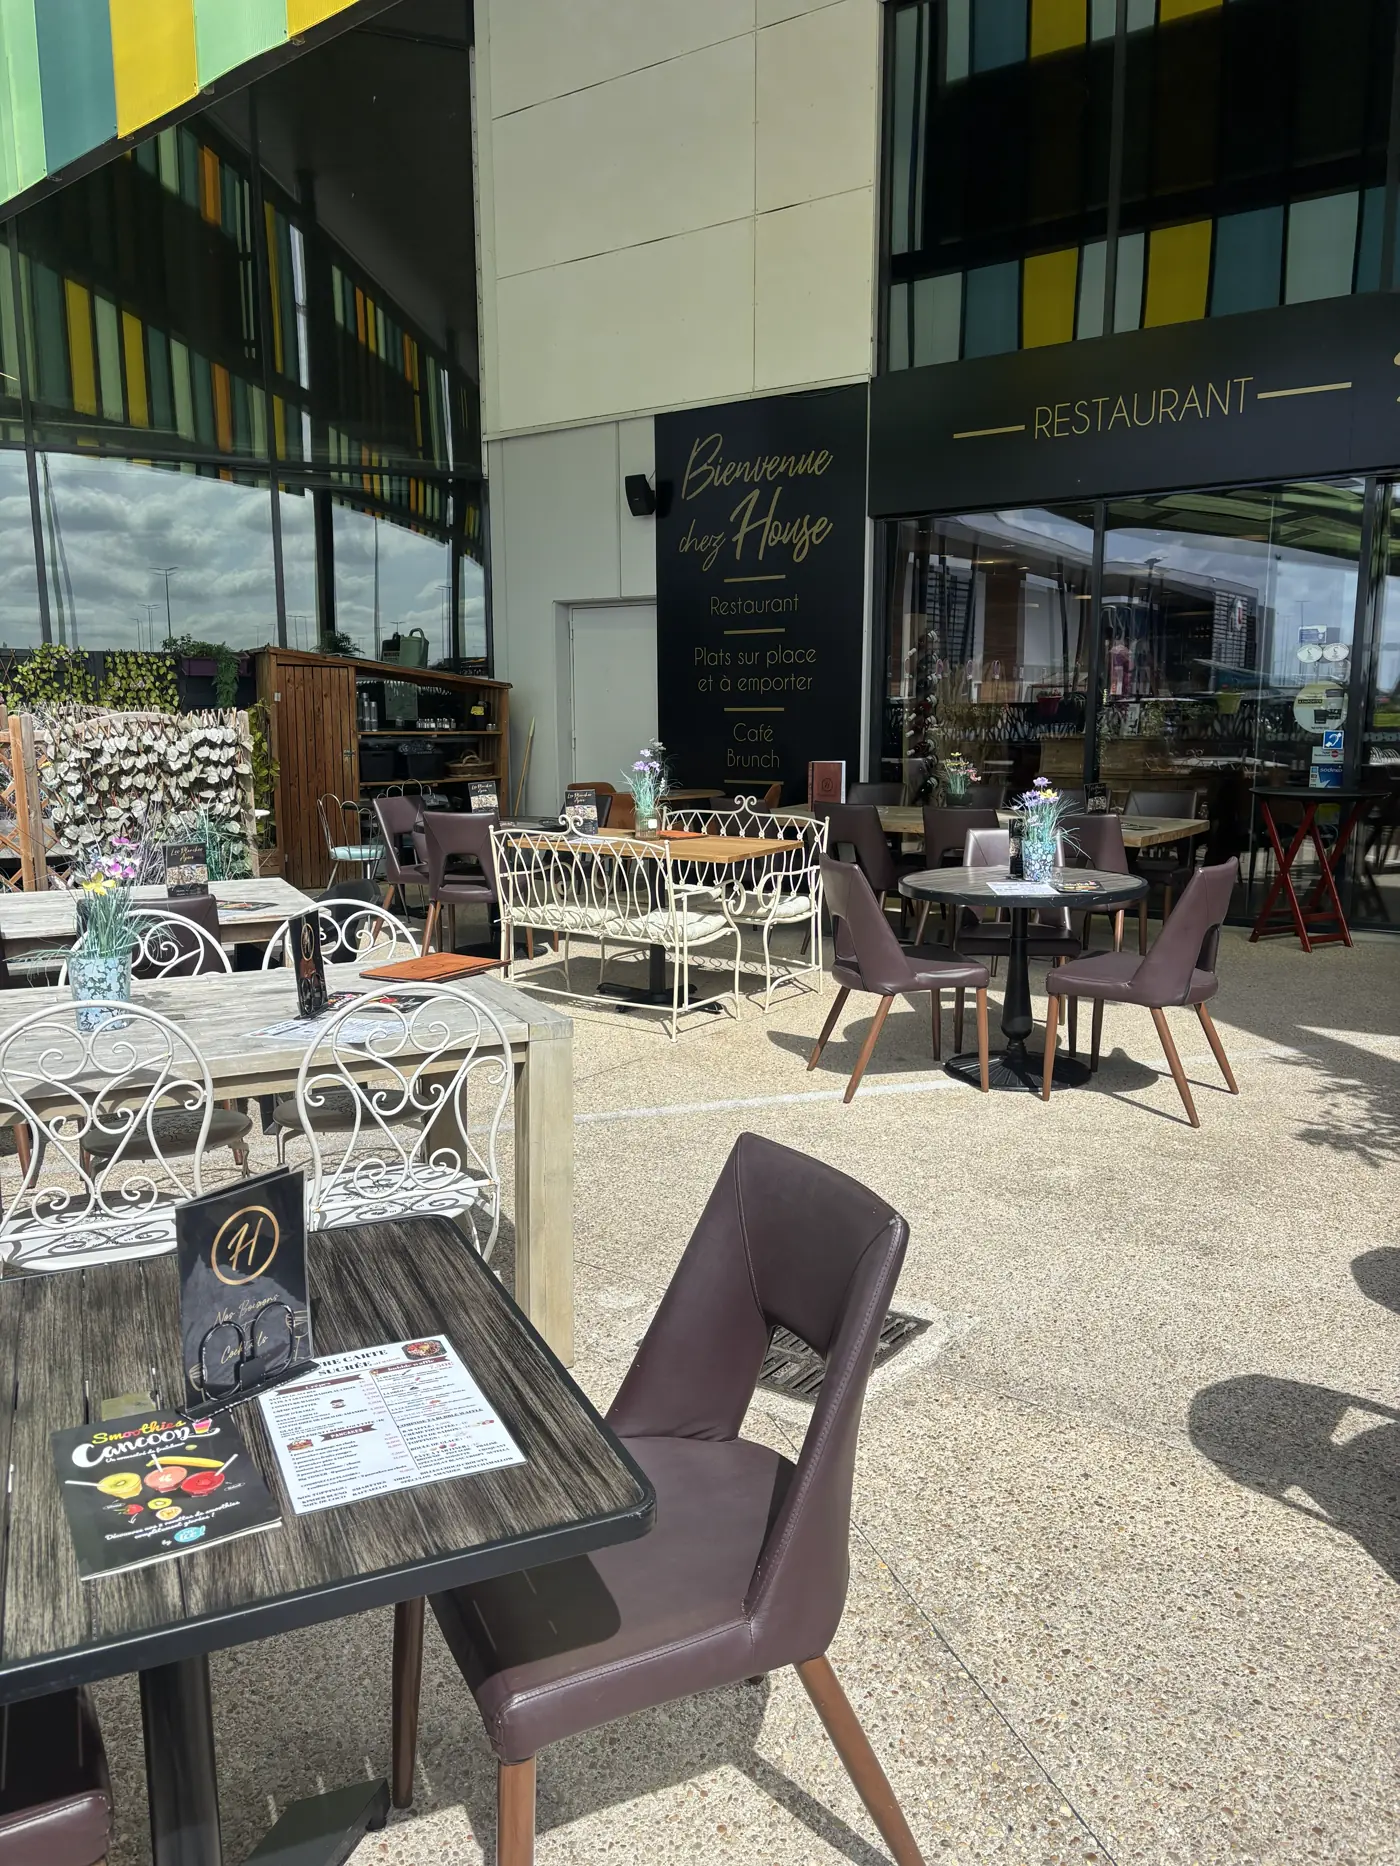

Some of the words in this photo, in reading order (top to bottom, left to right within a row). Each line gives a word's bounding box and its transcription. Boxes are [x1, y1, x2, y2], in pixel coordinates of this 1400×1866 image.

[1034, 376, 1254, 439] RESTAURANT
[681, 433, 833, 500] Bienvenue
[679, 518, 726, 571] chez
[729, 486, 833, 563] House
[710, 594, 799, 616] Restaurant
[694, 647, 731, 666] Plats
[737, 651, 760, 665] sur
[766, 644, 817, 669] place
[698, 675, 713, 692] et
[720, 674, 731, 692] à
[737, 673, 813, 695] emporter
[733, 722, 774, 742] Café
[727, 748, 780, 768] Brunch
[228, 1217, 264, 1271] H
[343, 1349, 388, 1364] CARTE
[92, 1420, 186, 1444] Smoothies
[330, 1428, 364, 1438] PANCAKES
[72, 1427, 193, 1467] Cancoon
